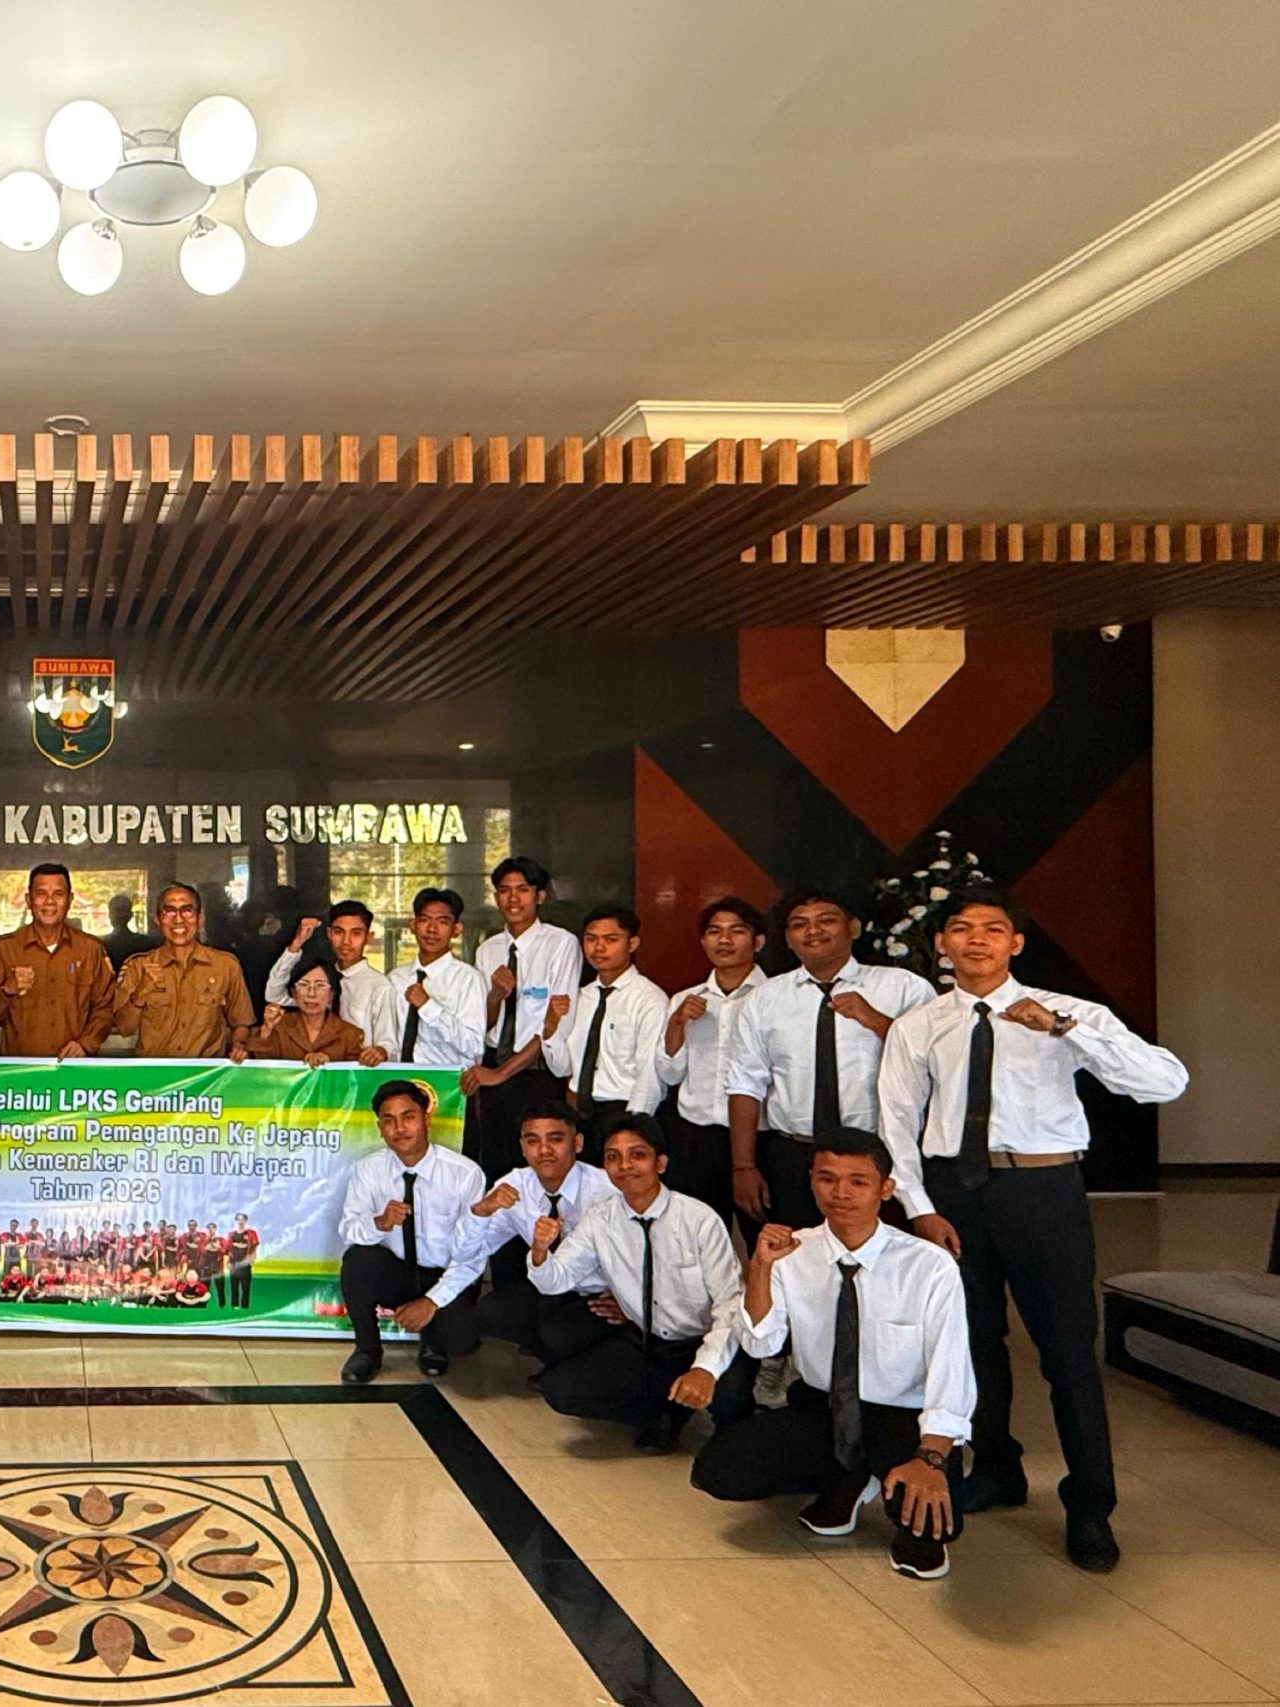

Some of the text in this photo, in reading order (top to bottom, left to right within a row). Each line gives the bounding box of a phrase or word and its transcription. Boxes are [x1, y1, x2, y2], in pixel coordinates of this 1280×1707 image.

[39, 662, 110, 673] SUMBAWA
[4, 803, 243, 845] KABUPATEN
[265, 802, 469, 845] SUMBAWA
[58, 1089, 118, 1112] LPKS
[124, 1089, 223, 1118] Gemilang
[85, 1119, 220, 1147] Pemagangan
[228, 1121, 256, 1145] Ke
[263, 1123, 341, 1150] Jepang
[8, 1148, 128, 1172] Kemenaker
[134, 1149, 158, 1173] RI
[164, 1151, 204, 1174] dan
[211, 1151, 306, 1180] IMJapan
[30, 1177, 161, 1203] Tahun 2026
